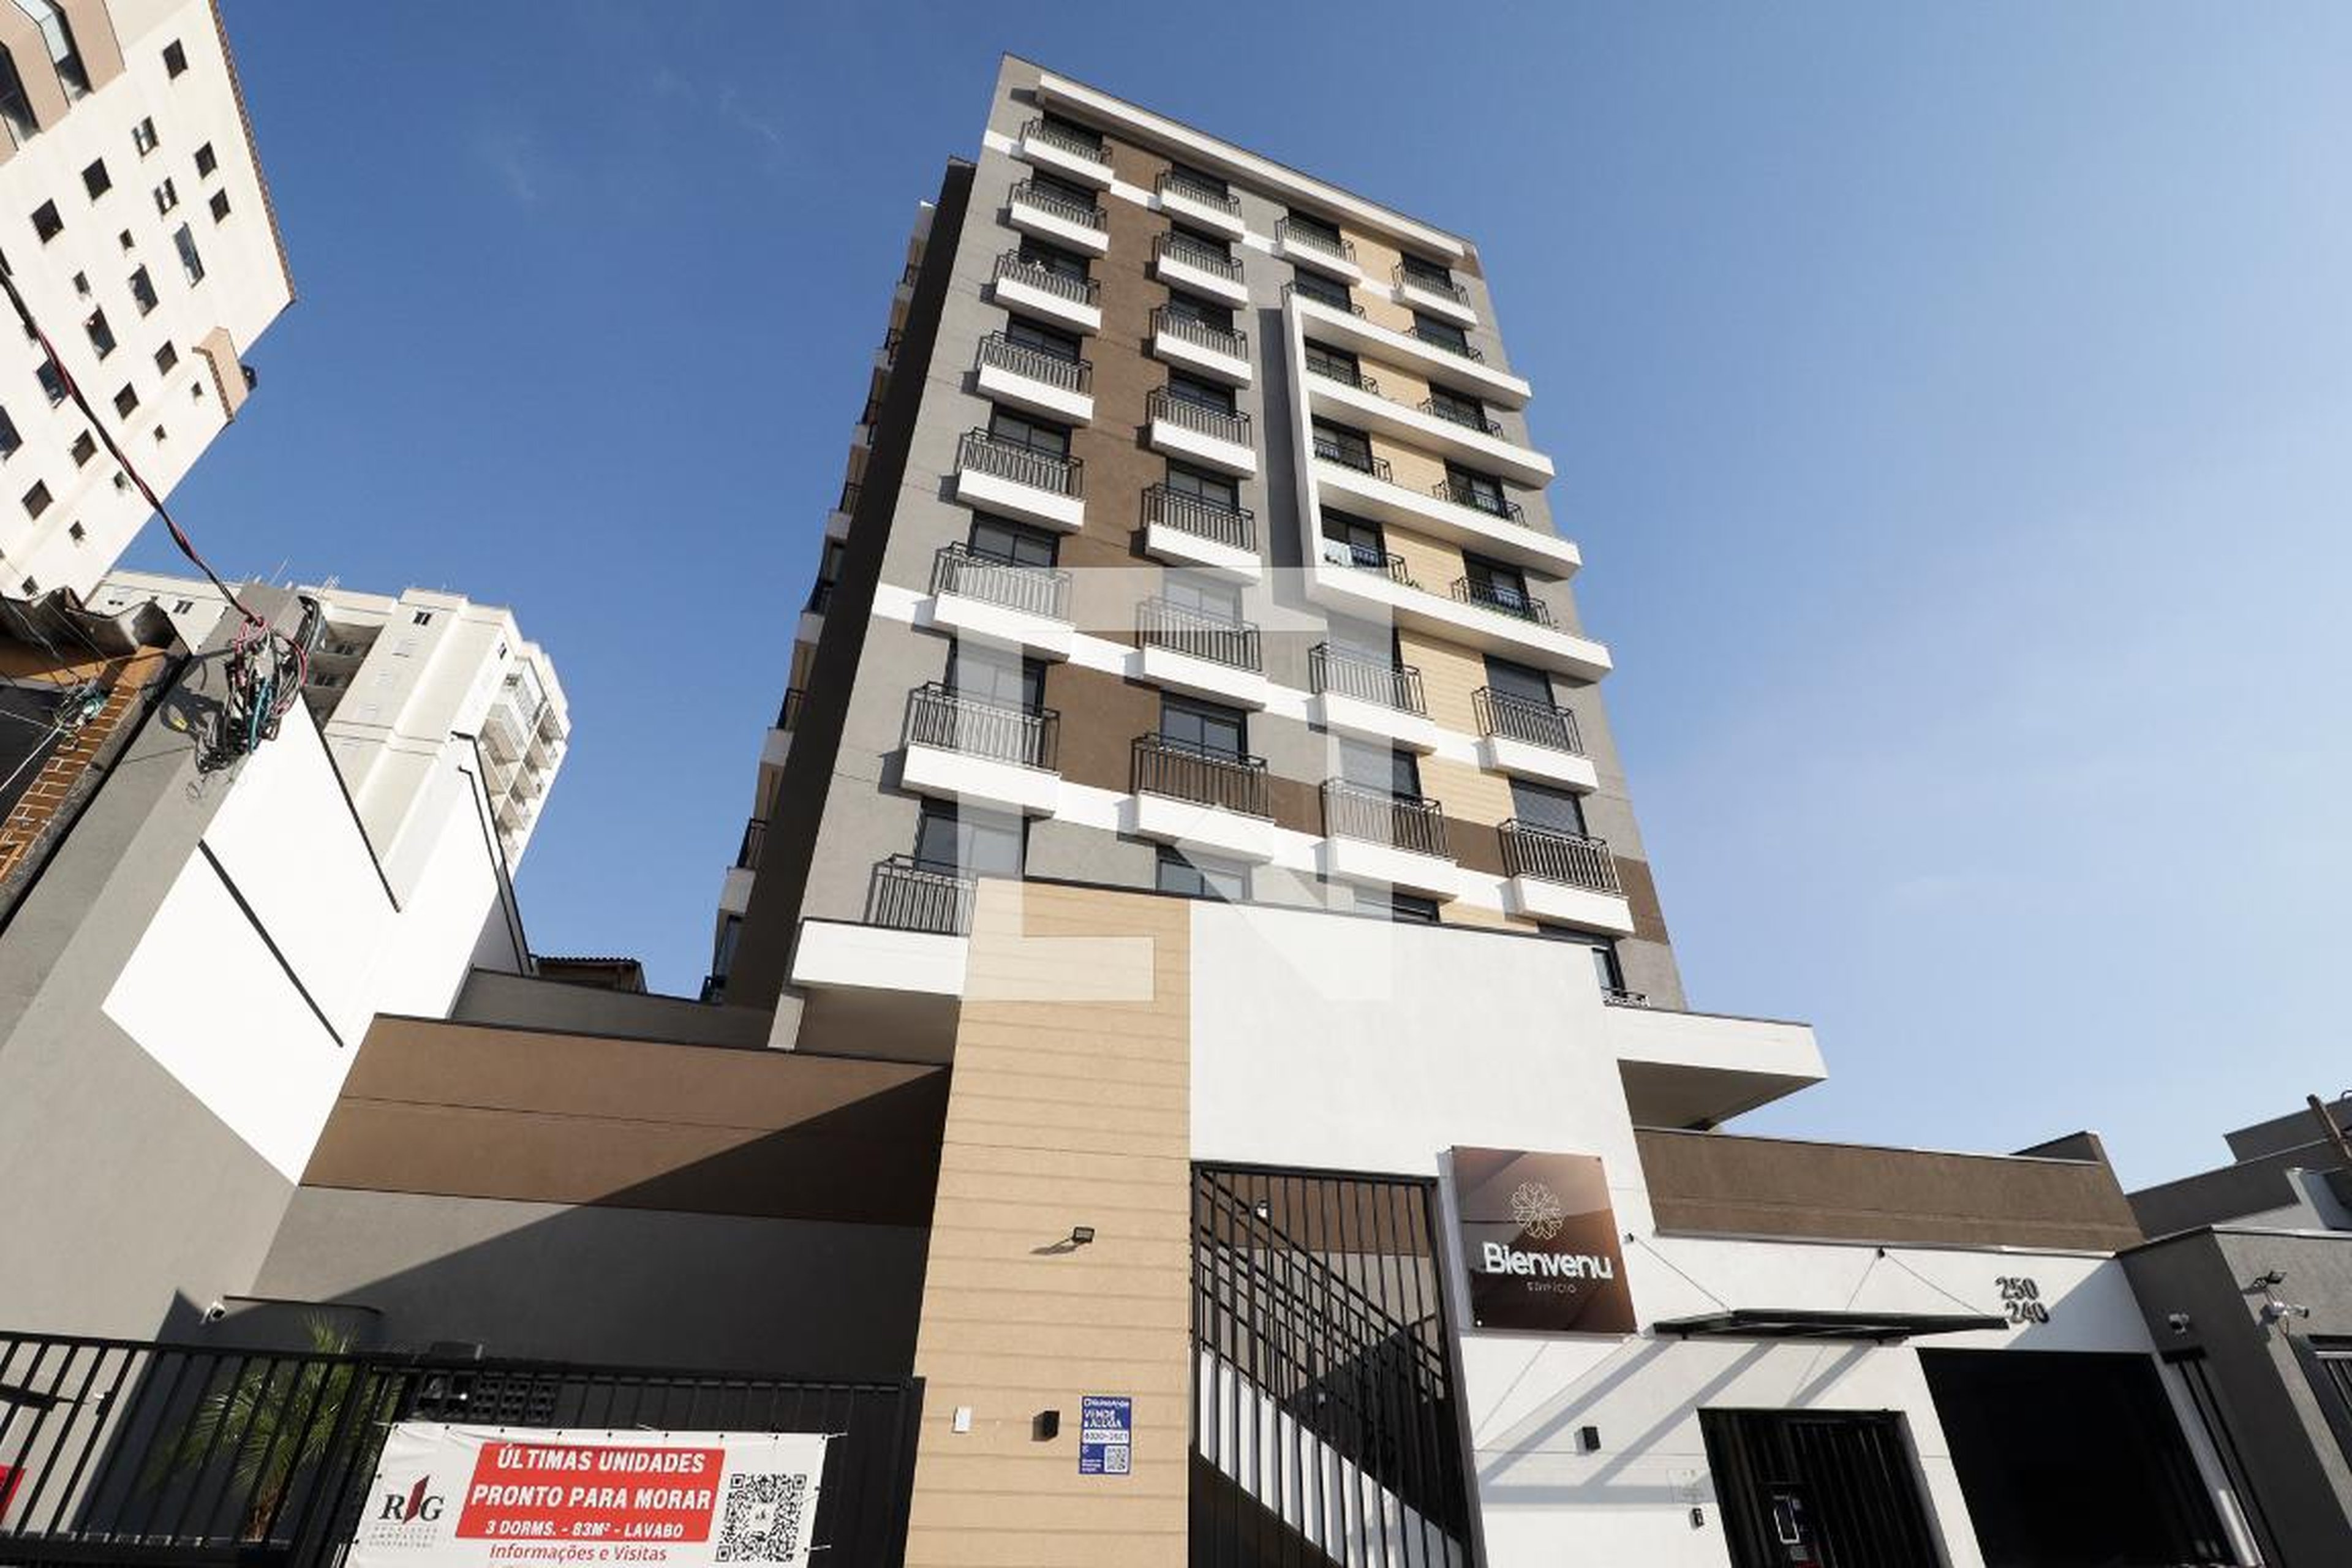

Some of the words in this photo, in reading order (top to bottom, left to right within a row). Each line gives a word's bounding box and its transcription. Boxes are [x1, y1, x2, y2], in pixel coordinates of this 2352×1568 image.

[1482, 1242, 1613, 1279] Bienvenu
[1995, 1276, 2039, 1300] 250
[2005, 1300, 2049, 1324] 240
[497, 1443, 593, 1471] ÚLTIMAS
[599, 1451, 705, 1473] UNIDADES
[470, 1484, 564, 1507] PRONTO
[567, 1487, 627, 1510] PARA
[634, 1488, 712, 1510] MORAR
[485, 1519, 497, 1535] 3
[499, 1520, 557, 1536] DORMS.
[624, 1523, 684, 1538] LAVABO
[489, 1543, 594, 1563] Informações
[600, 1548, 609, 1561] e
[614, 1544, 668, 1561] Visitas
